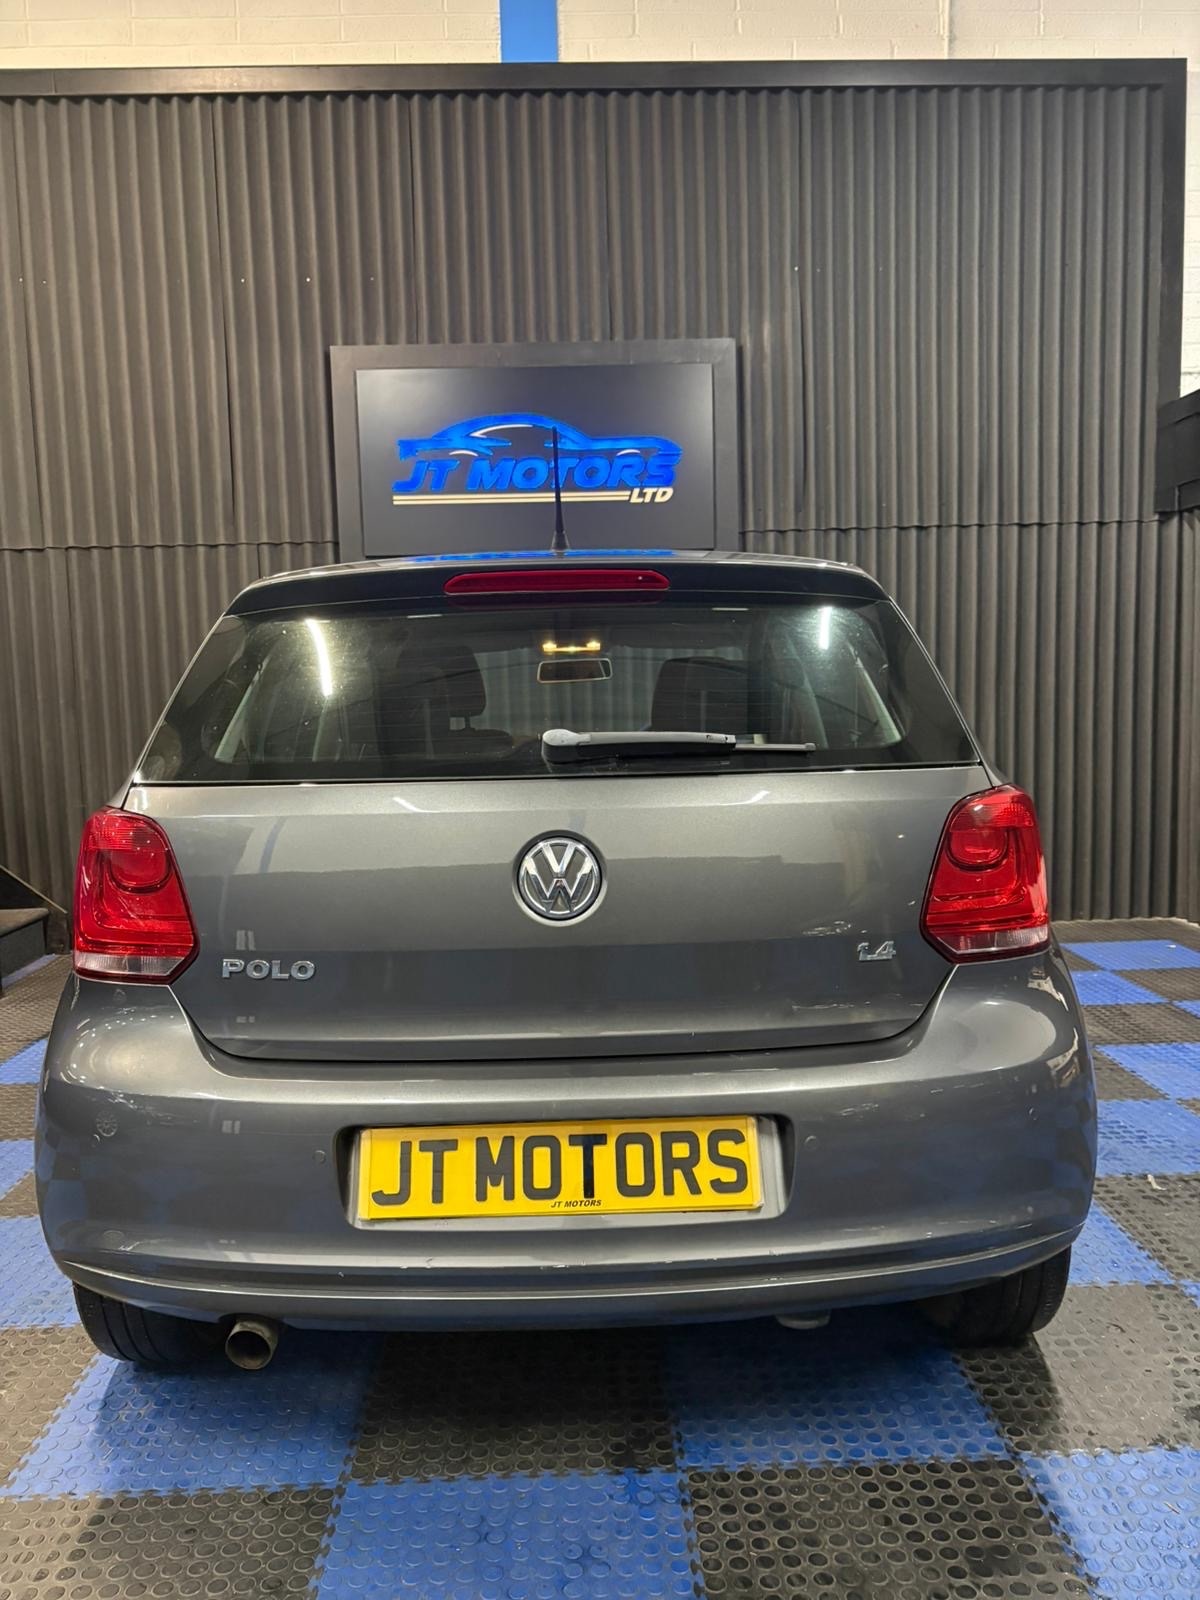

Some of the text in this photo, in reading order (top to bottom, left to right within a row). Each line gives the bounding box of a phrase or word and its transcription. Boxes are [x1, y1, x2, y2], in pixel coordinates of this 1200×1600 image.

[392, 455, 678, 492] JT MOTORS
[630, 487, 674, 503] LTD
[222, 958, 315, 980] POLO
[371, 1128, 749, 1207] JT MOTORS
[550, 1199, 602, 1208] JT MOTORS
